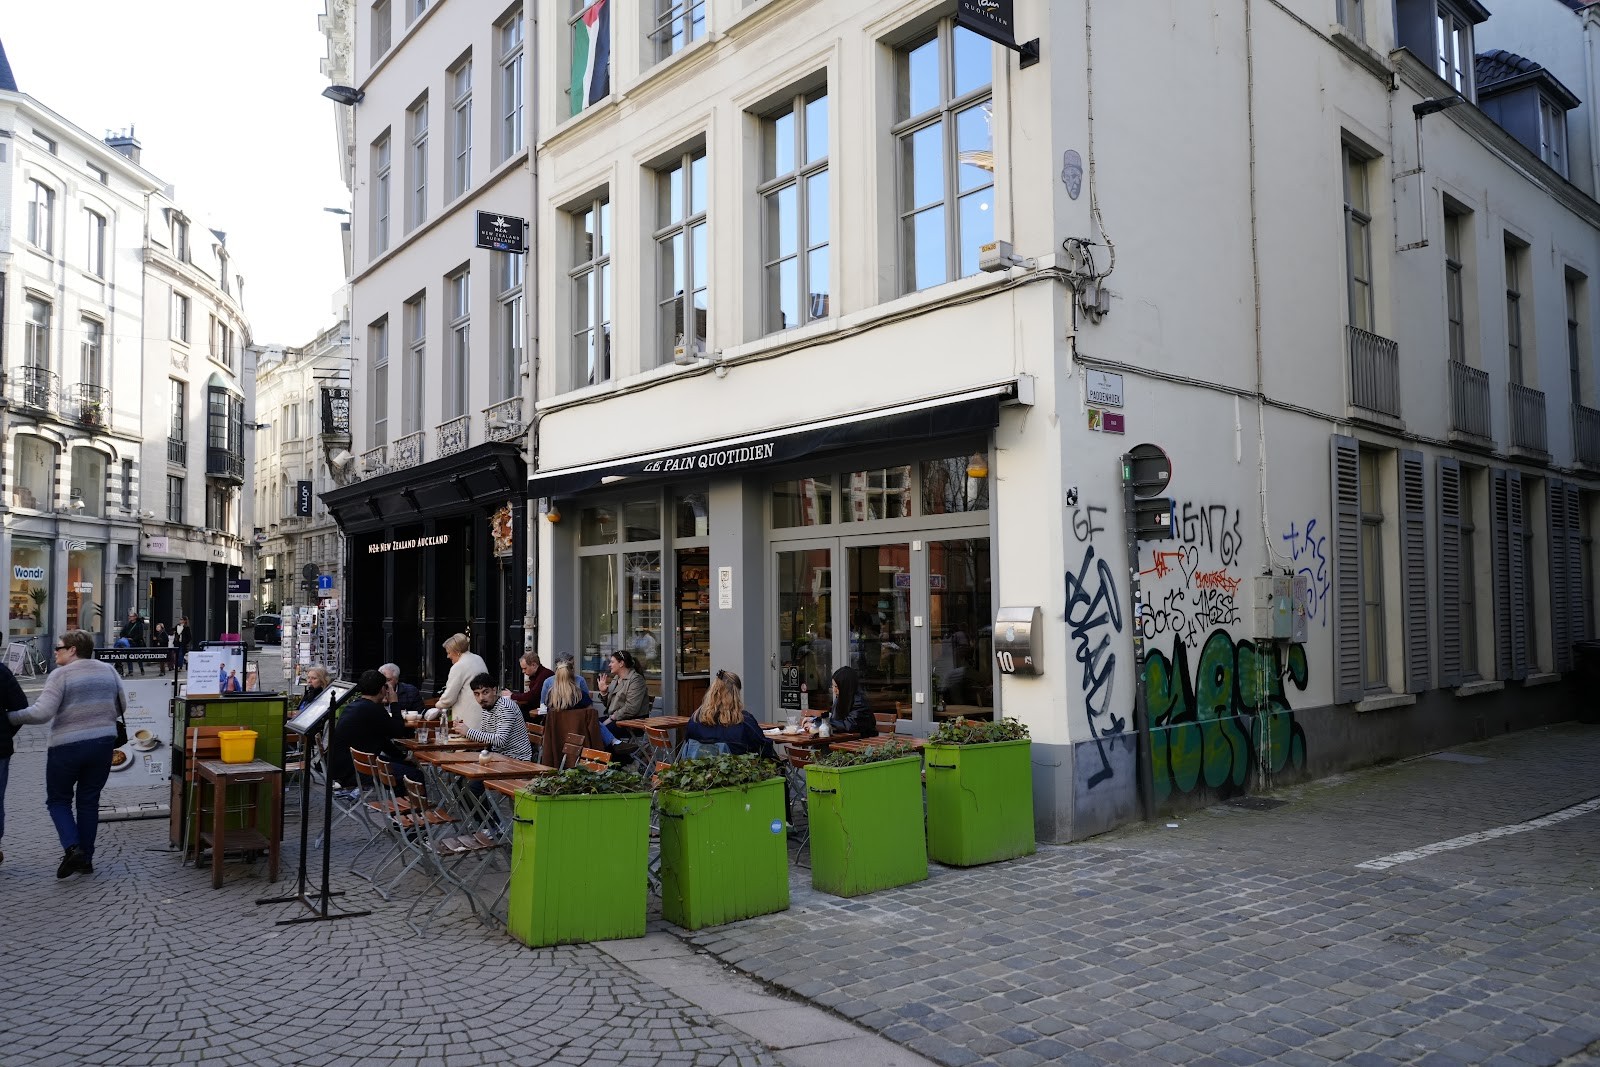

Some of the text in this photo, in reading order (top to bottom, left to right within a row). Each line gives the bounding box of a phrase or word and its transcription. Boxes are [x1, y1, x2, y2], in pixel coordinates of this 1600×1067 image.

[964, 2, 1007, 26] QUOTIDIEN
[486, 236, 515, 244] AUCKLAND
[1089, 390, 1121, 404] PADDENHOEK
[643, 442, 775, 472] LE PAIN QUOTIDIEN
[380, 542, 392, 552] NEW
[392, 539, 416, 551] ZEALAND
[416, 534, 449, 548] AUCKLAND
[14, 566, 44, 579] Wondr
[996, 650, 1015, 673] 10
